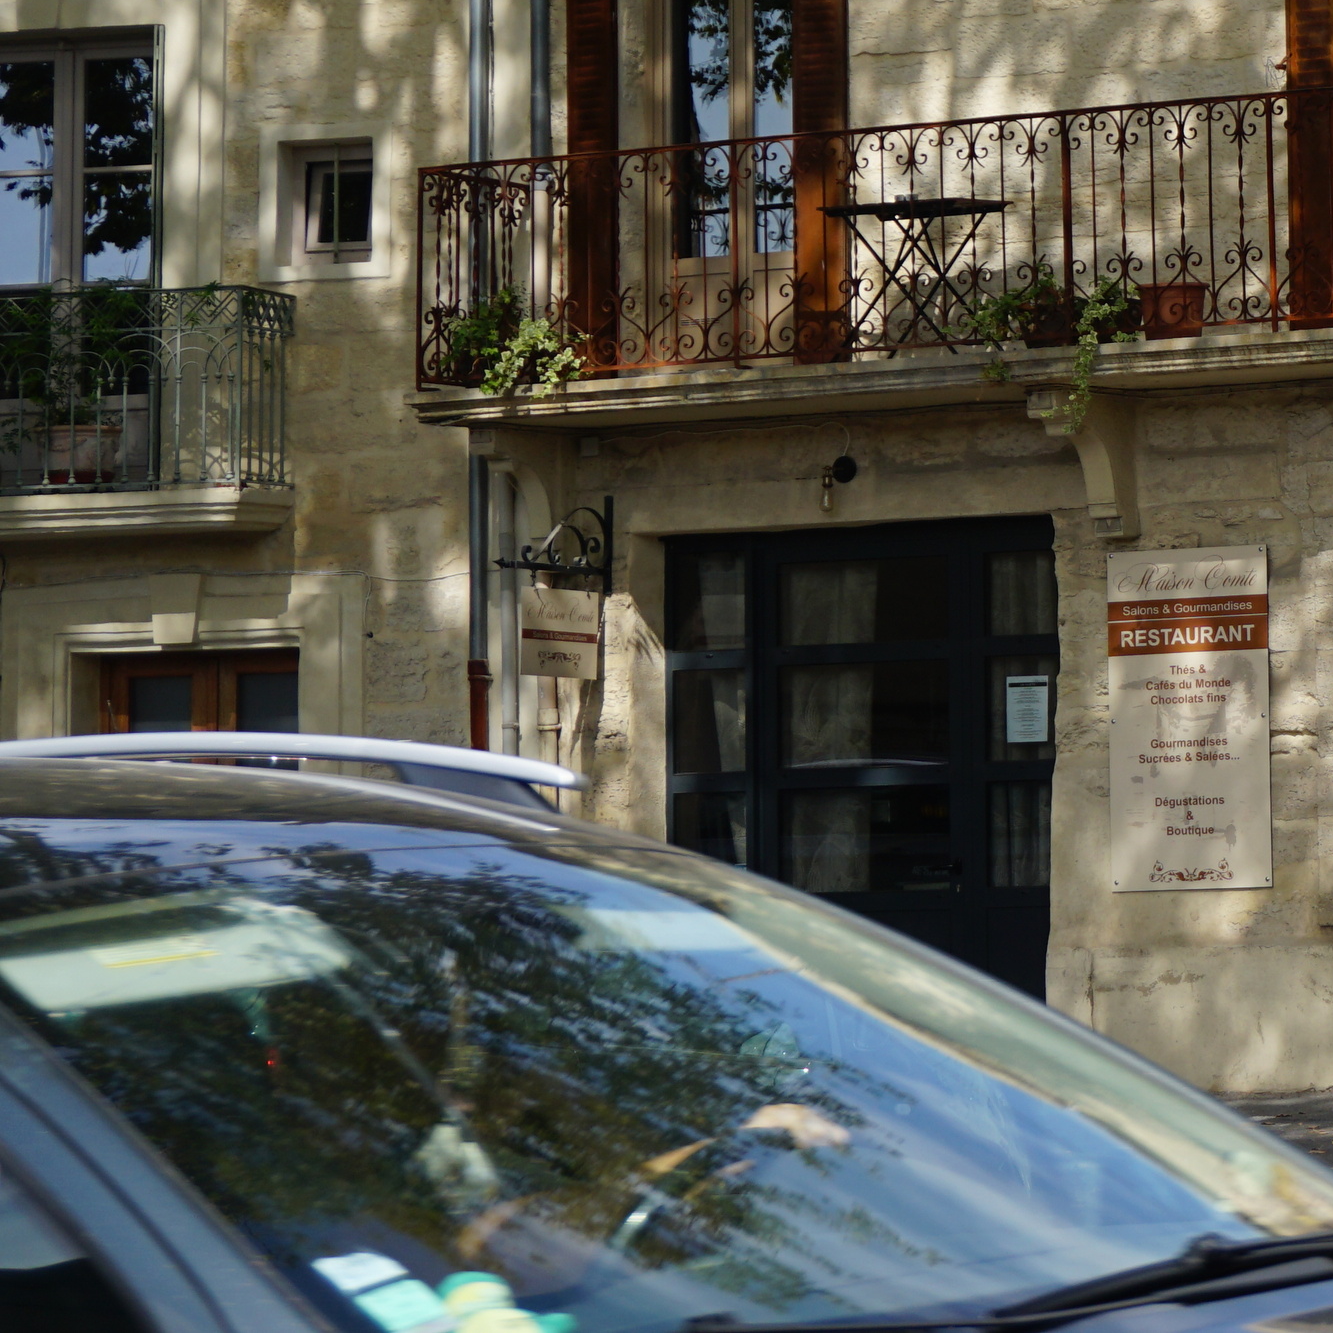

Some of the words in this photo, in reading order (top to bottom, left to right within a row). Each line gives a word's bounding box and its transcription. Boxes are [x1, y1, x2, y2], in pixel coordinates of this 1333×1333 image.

[1114, 562, 1195, 594] Maison
[1195, 555, 1258, 592] Comte
[1122, 605, 1160, 616] Salons
[1163, 604, 1170, 614] &
[1173, 600, 1252, 614] Gourmandises
[1120, 624, 1255, 648] RESTAURANT
[1169, 665, 1195, 675] Thés
[1198, 664, 1206, 674] &
[1146, 680, 1175, 691] Cafés
[1179, 679, 1192, 689] du
[1195, 678, 1231, 688] Monde
[1150, 694, 1203, 705] Chocolats
[1206, 692, 1227, 703] fins
[1150, 737, 1228, 748] Gourmandises
[1138, 753, 1182, 764] Sucrées
[1184, 752, 1192, 762] &
[1195, 750, 1240, 762] Salées...
[1155, 795, 1225, 808] Dégustations
[1186, 810, 1194, 821] &
[1166, 824, 1215, 837] Boutique
